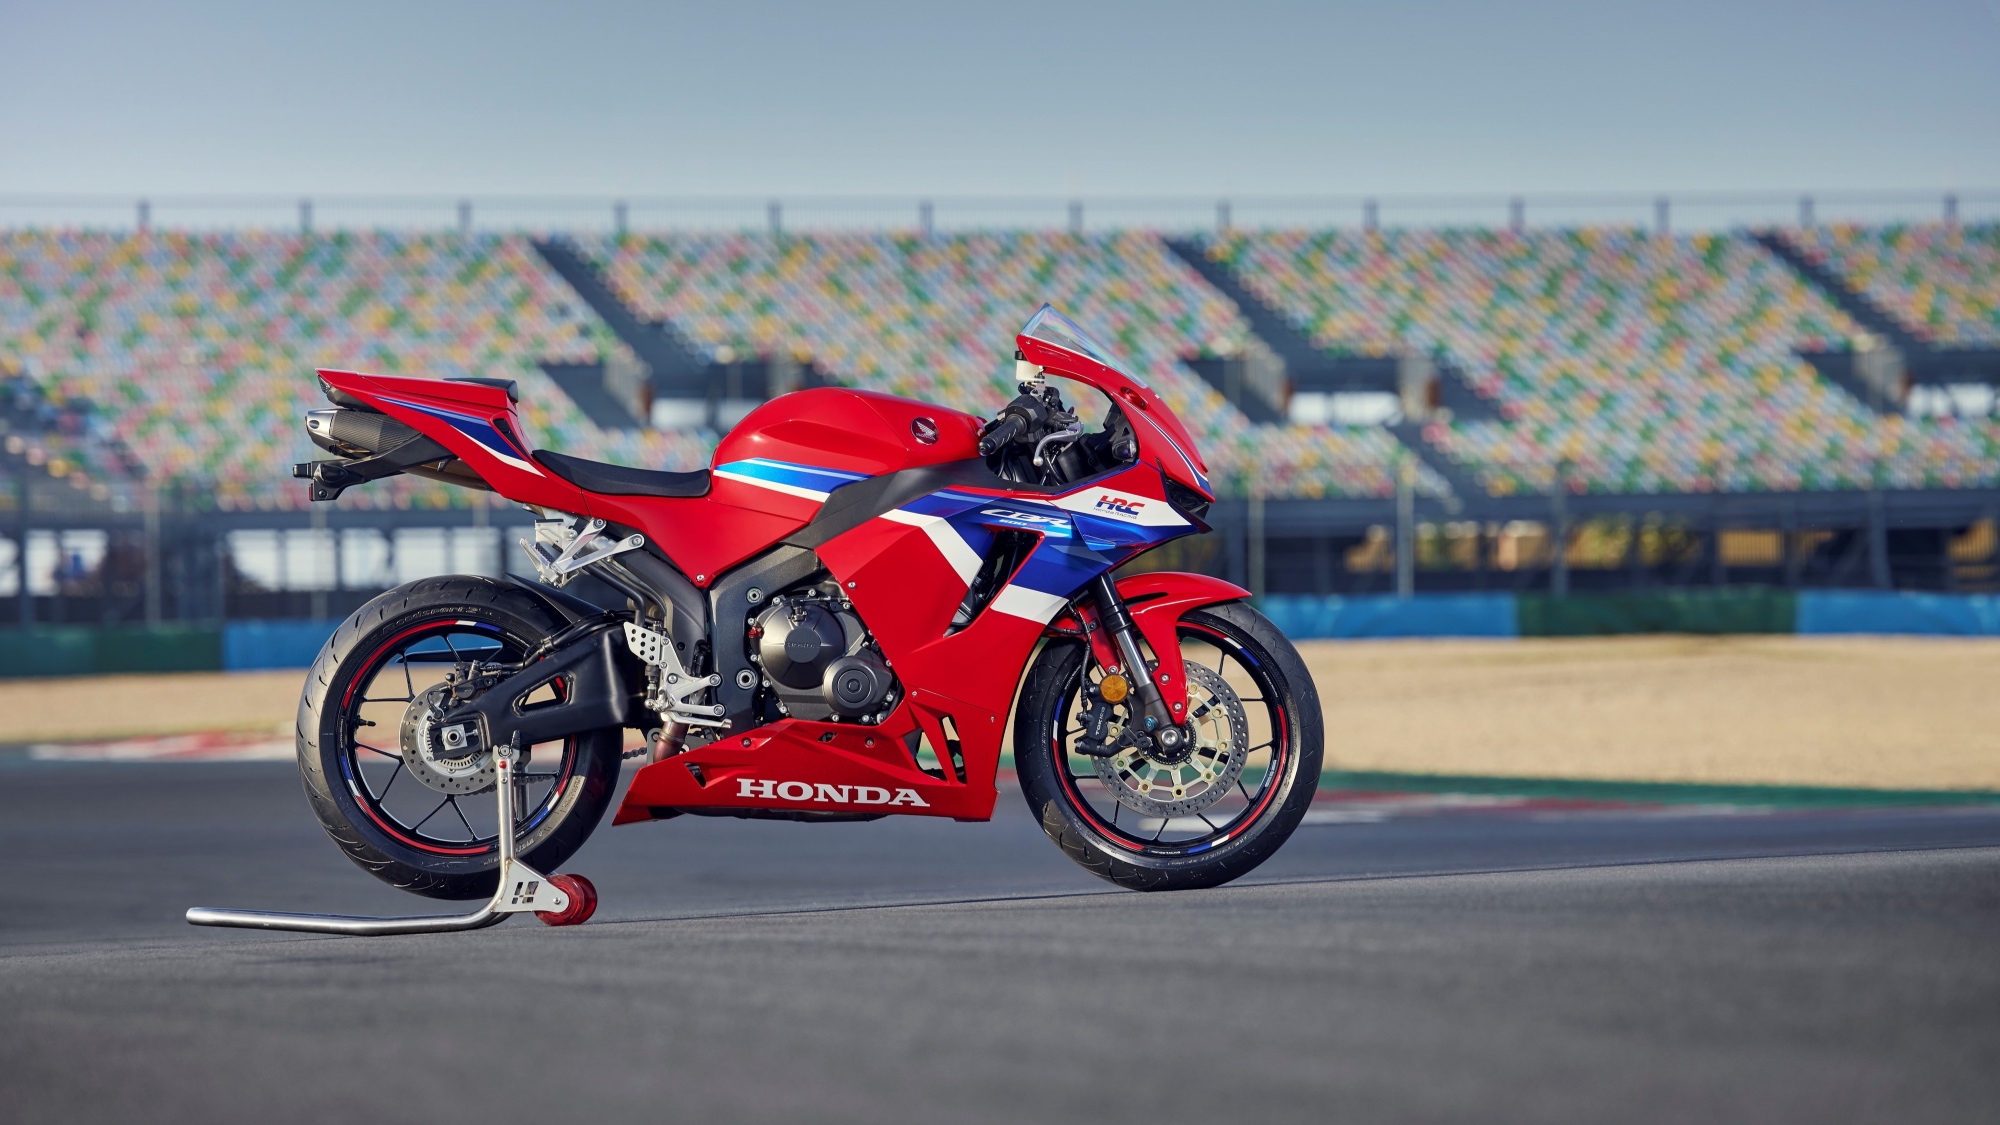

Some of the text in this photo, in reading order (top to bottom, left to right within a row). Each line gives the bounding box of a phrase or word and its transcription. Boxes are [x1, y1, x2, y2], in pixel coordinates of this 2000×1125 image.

[1096, 495, 1145, 516] HRC
[980, 508, 1069, 527] CBR
[736, 778, 931, 808] HONDA
